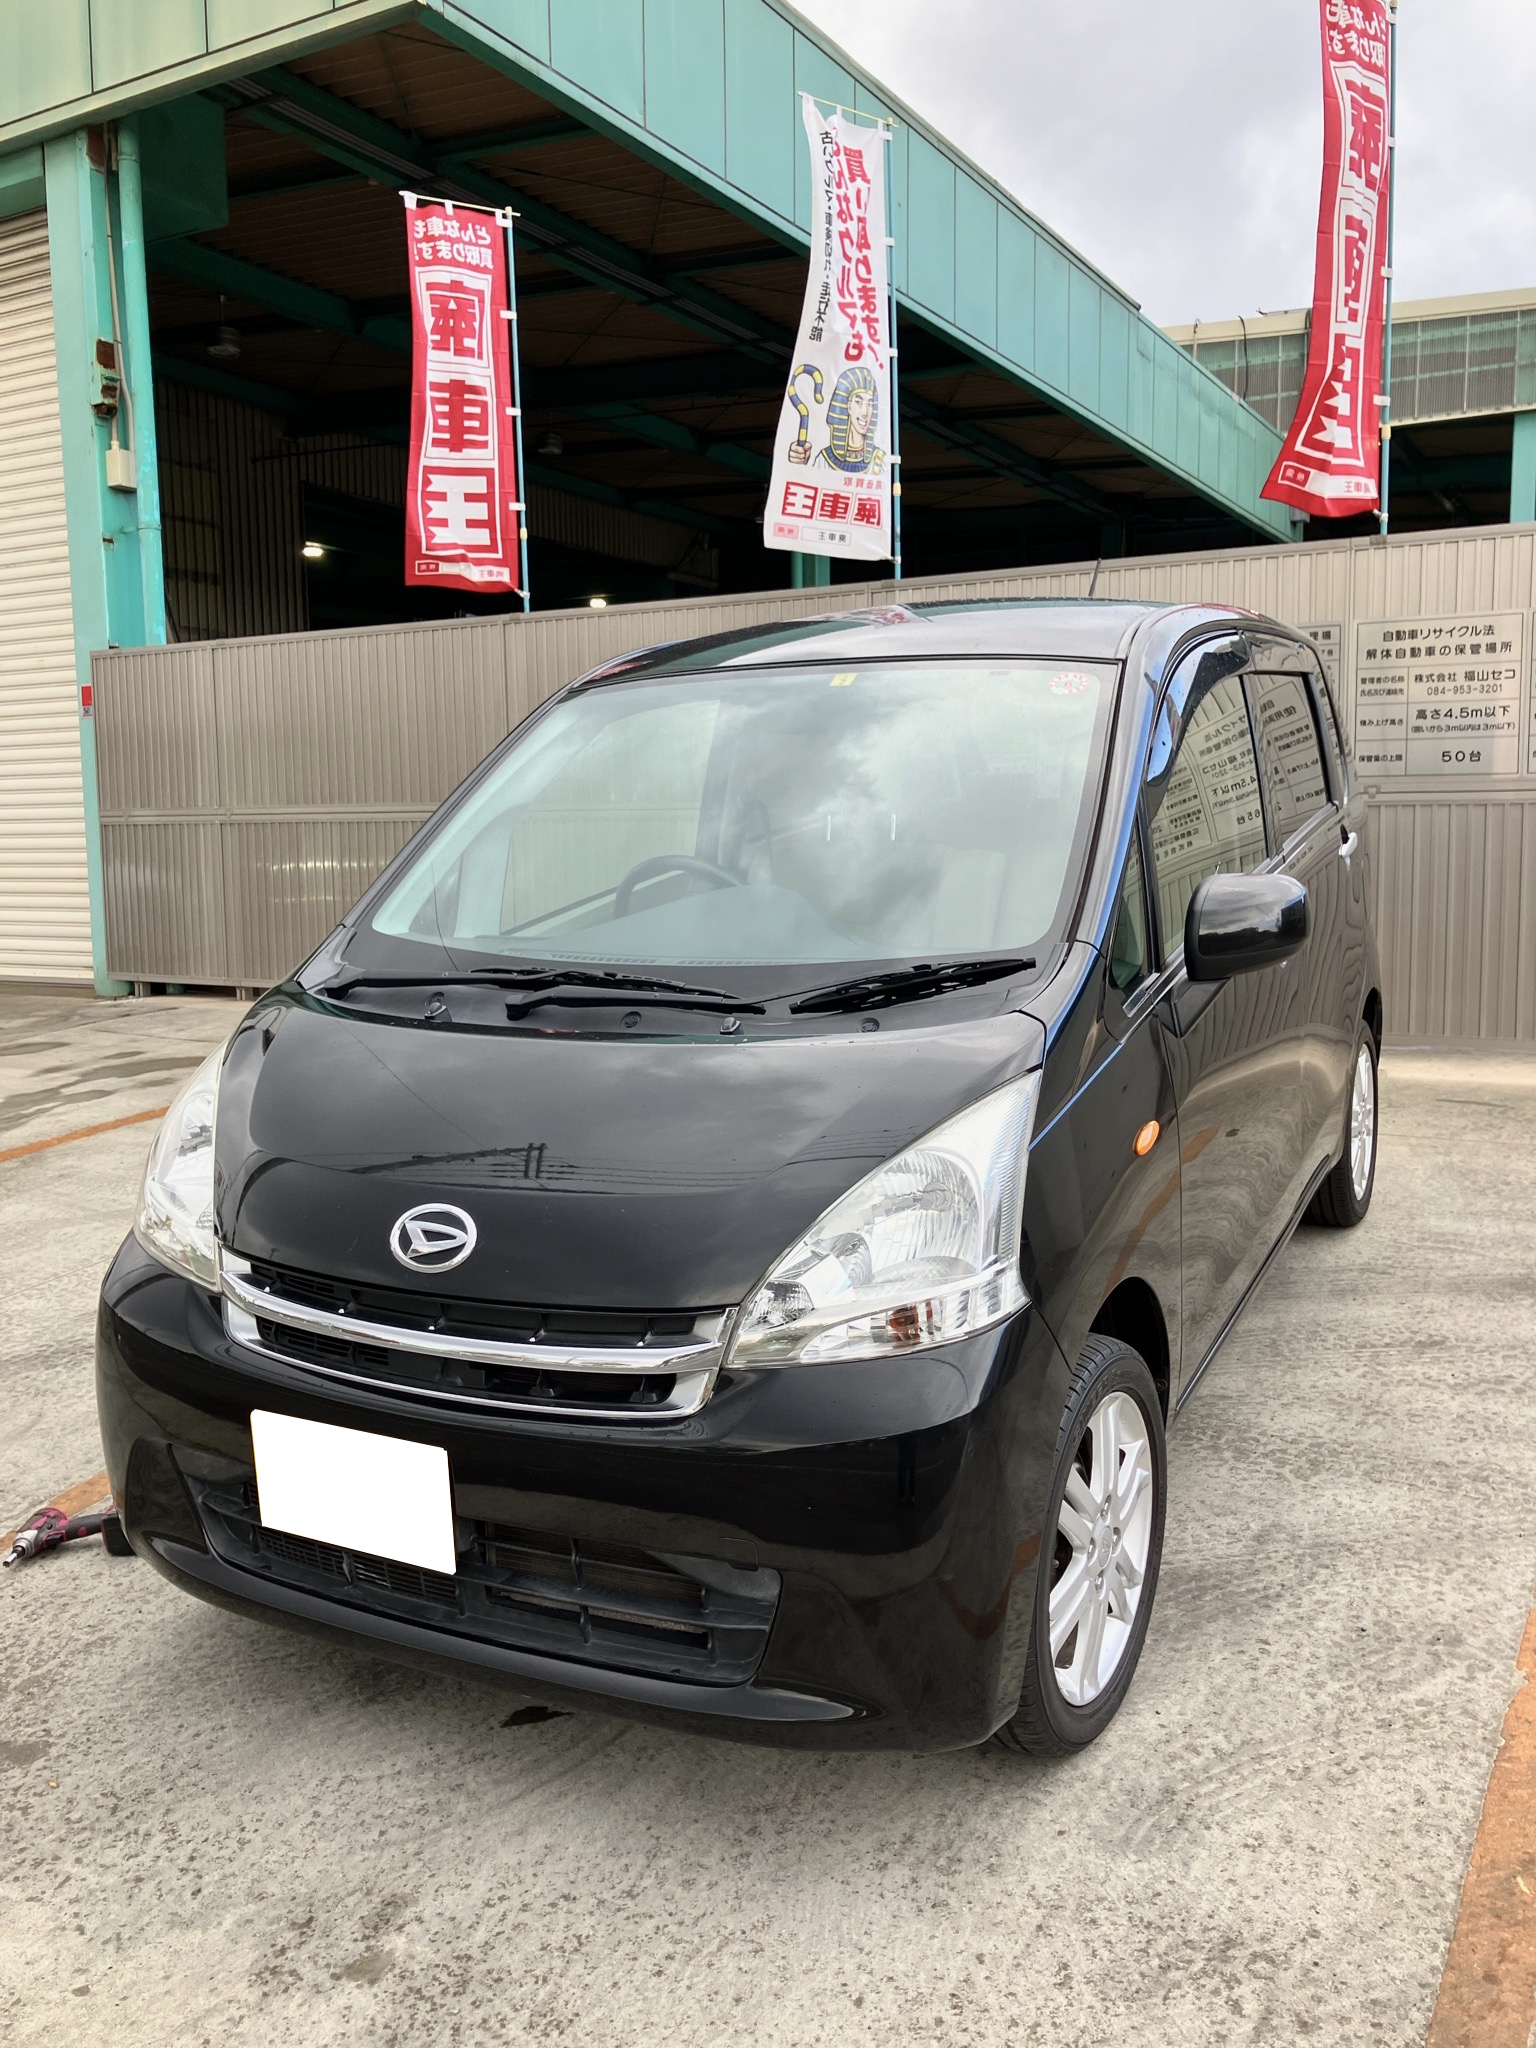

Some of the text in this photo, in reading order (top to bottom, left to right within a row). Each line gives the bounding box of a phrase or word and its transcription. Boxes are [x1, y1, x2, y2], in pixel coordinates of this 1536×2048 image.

[1383, 625, 1495, 642] 自動車リサイクル法
[1366, 641, 1512, 660] 解体自動車の保管場所
[1414, 668, 1516, 683] 株式会社 福山セコ
[1427, 683, 1503, 696] 084-953-3201
[1415, 705, 1510, 720] 高さ4.5m以下
[1441, 750, 1482, 763] 50台
